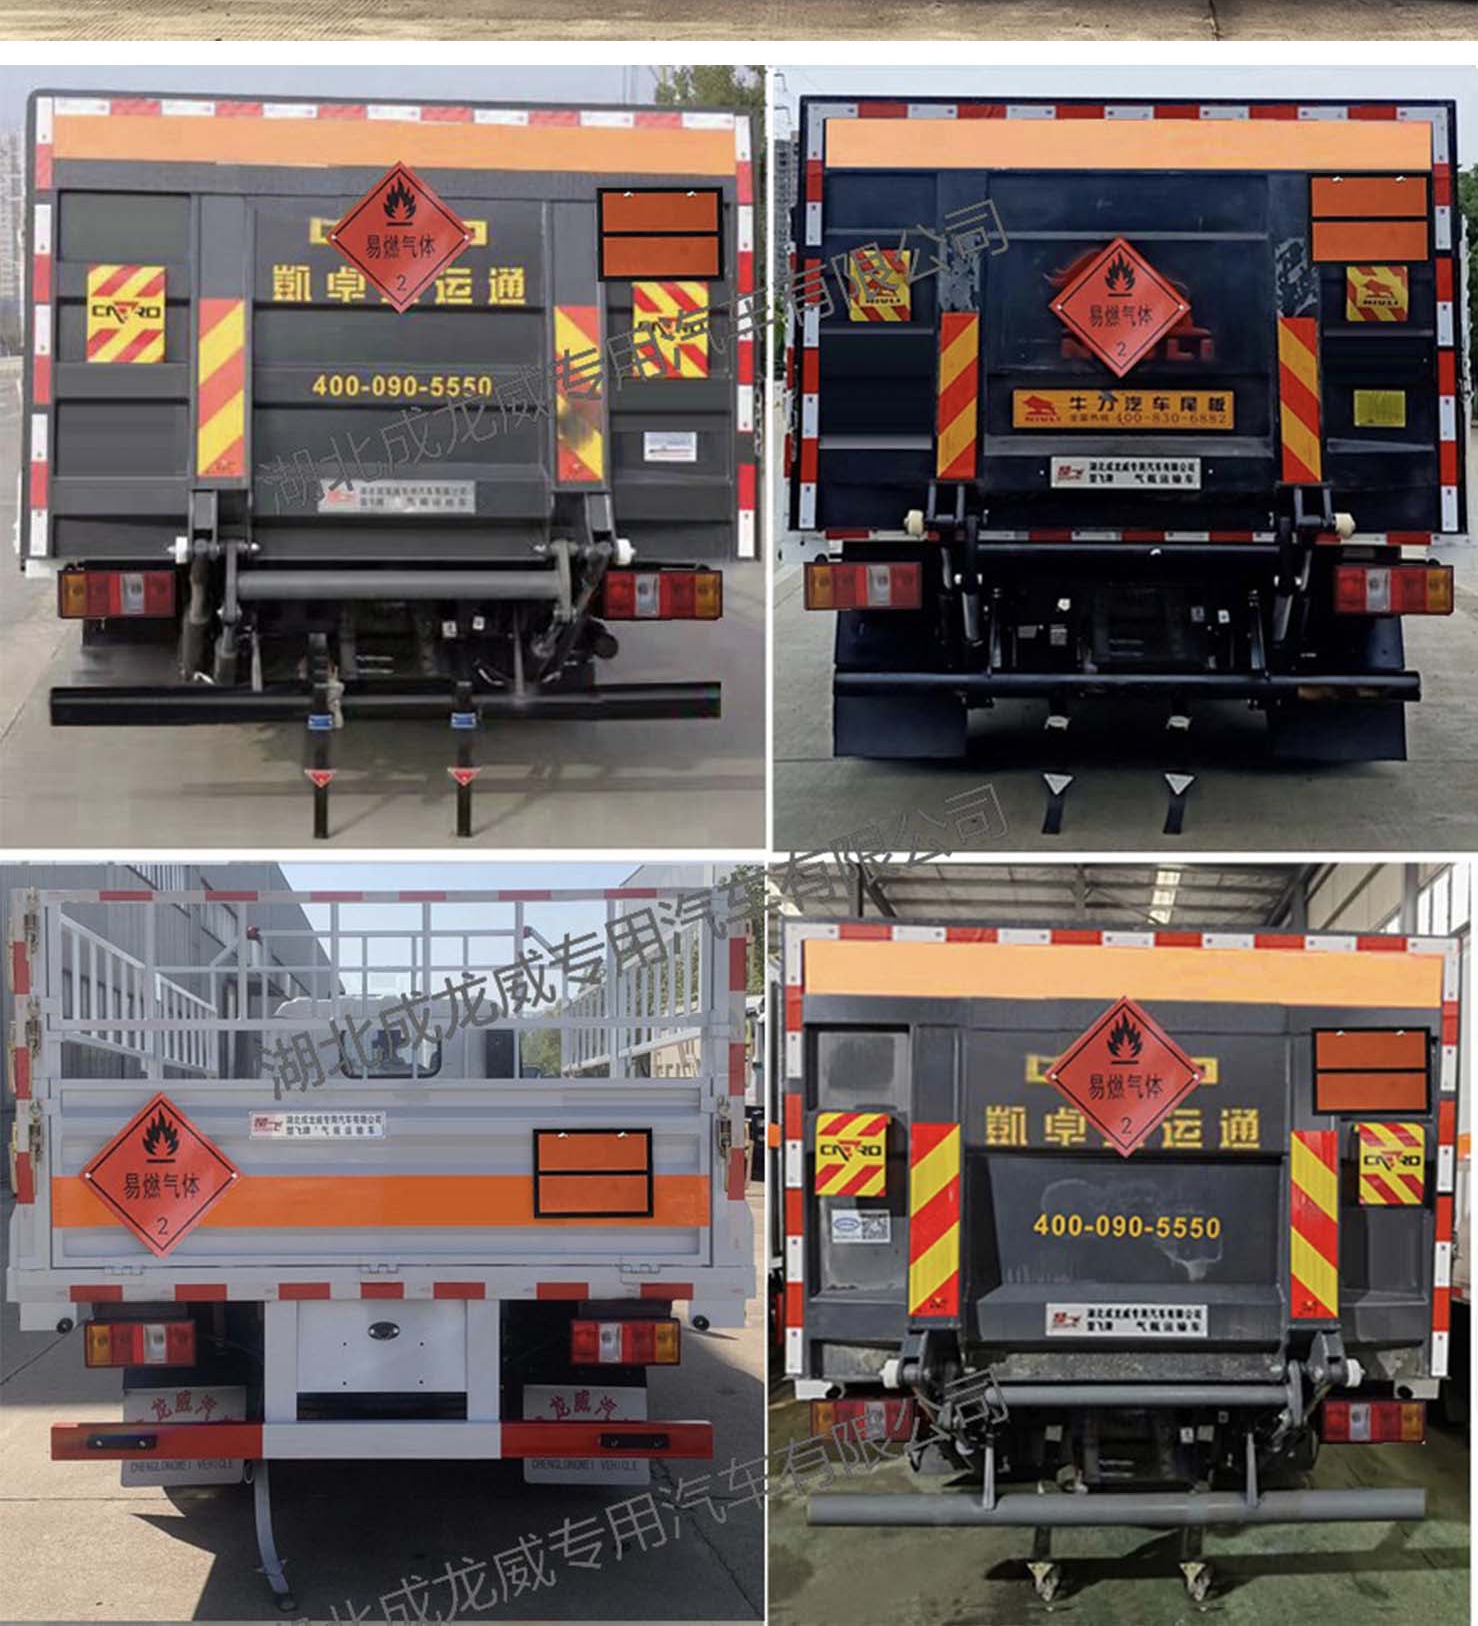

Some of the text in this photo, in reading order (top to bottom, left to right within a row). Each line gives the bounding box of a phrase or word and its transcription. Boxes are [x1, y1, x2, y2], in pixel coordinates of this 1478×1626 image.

[365, 234, 437, 259] 易燃气体
[272, 264, 527, 305] 凱卓运通
[395, 274, 407, 292] 2
[1090, 305, 1152, 327] 易燃气体
[1115, 340, 1127, 357] 2
[312, 374, 493, 397] 400-090-5550
[1089, 1073, 1164, 1100] 易燃气体
[985, 1105, 1261, 1149] 凱卓运通
[1120, 1117, 1132, 1134] 2
[123, 1172, 200, 1199] 易燃气体
[156, 1217, 169, 1236] 2
[1033, 1213, 1222, 1238] 400-090-5550
